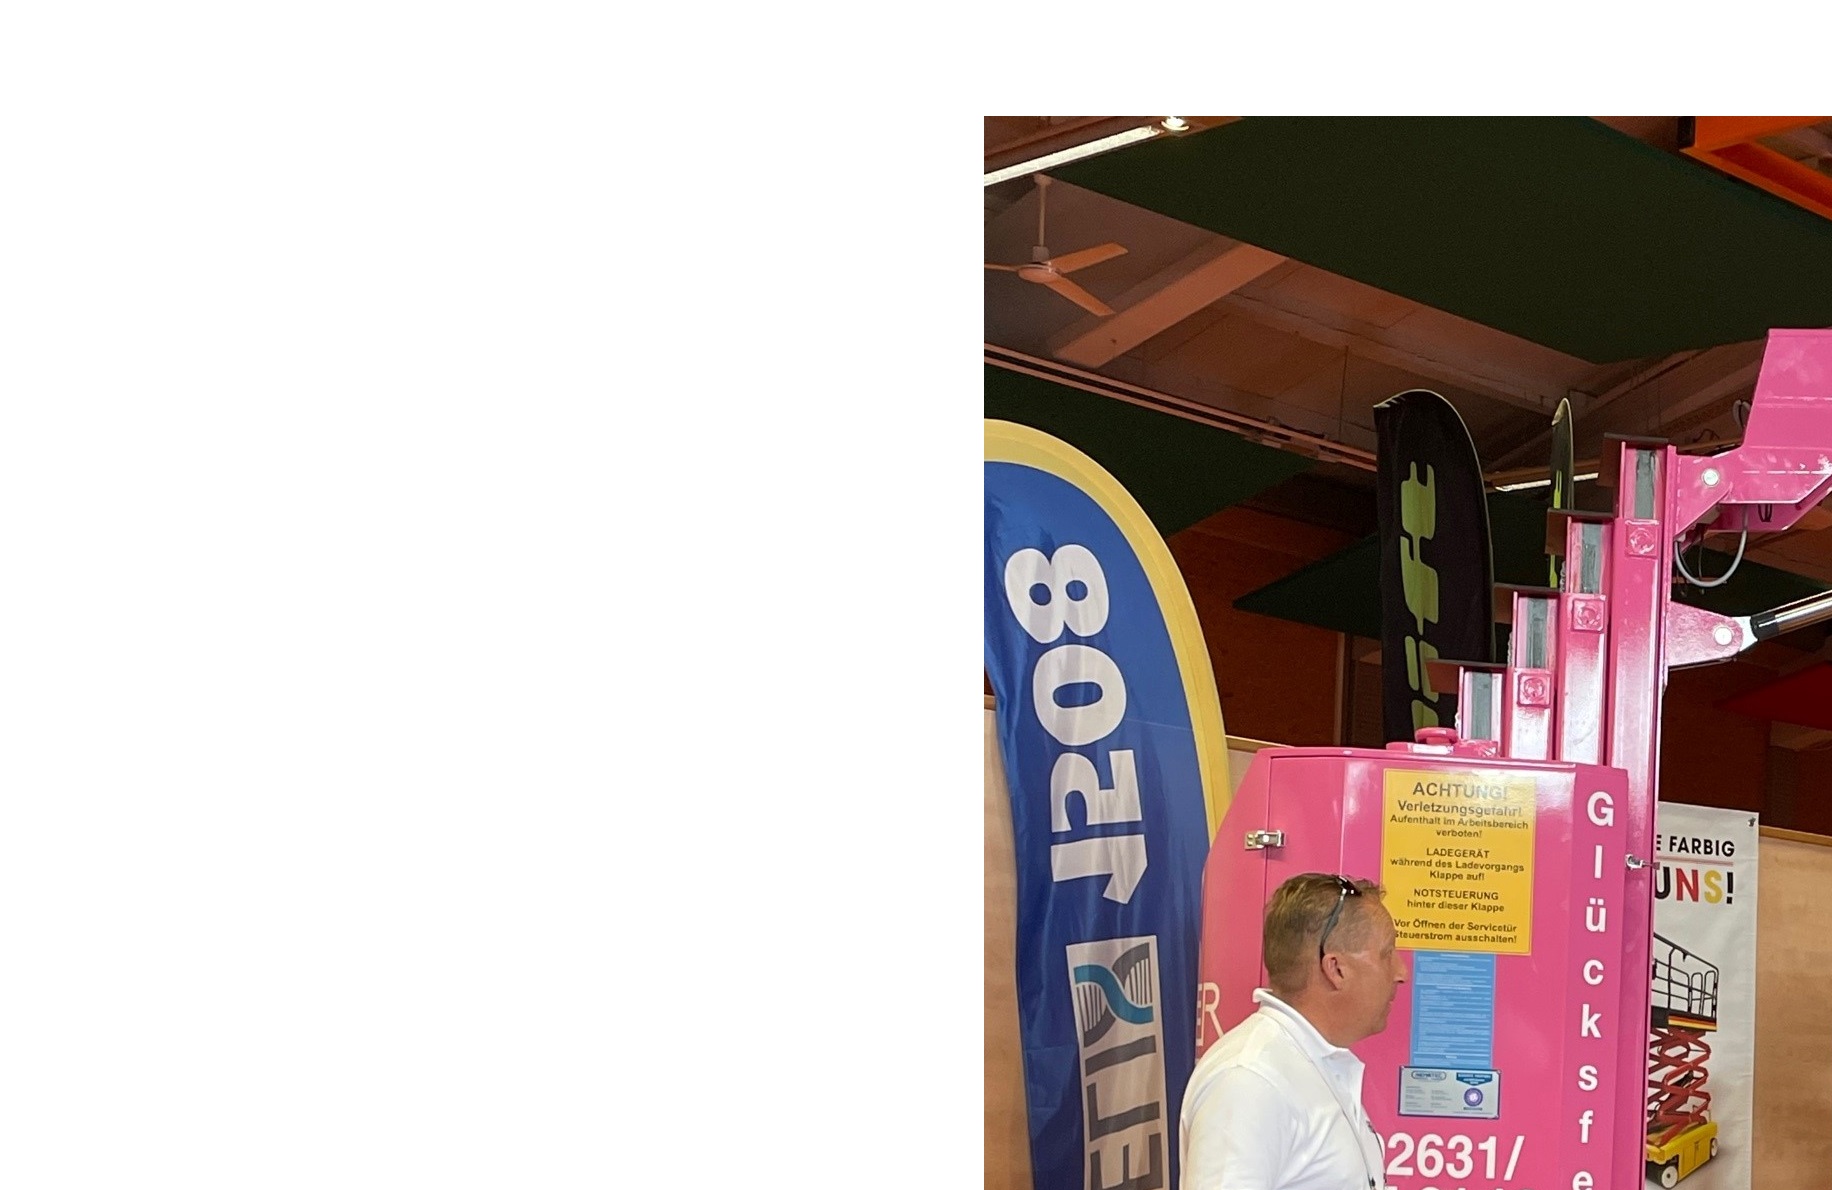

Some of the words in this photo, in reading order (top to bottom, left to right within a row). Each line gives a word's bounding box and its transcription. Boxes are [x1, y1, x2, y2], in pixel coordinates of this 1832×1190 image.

[1413, 782, 1508, 800] ACHTUNG!
[1398, 800, 1522, 817] Verletzungsgefahr!
[1390, 814, 1441, 825] Aufenthalt
[1443, 817, 1456, 826] im
[1457, 818, 1529, 830] Arbeitsbereich
[1436, 828, 1483, 838] verboten!
[1426, 847, 1490, 859] LADEGERÄT
[1669, 835, 1735, 857] FARBIG
[1390, 858, 1432, 868] während
[1435, 860, 1452, 868] des
[1455, 861, 1525, 874] Ladevorgangs
[1430, 871, 1463, 881] Klappe
[1466, 872, 1485, 881] auf!
[1654, 866, 1734, 904] UNS!
[1414, 889, 1499, 900] NOTSTEUERUNG
[1407, 899, 1435, 910] hinter
[1438, 901, 1468, 911] dieser
[1471, 902, 1505, 913] Klappe
[1393, 918, 1410, 928] Vor
[1413, 918, 1446, 929] Öffnen
[1449, 920, 1464, 930] der
[1467, 921, 1517, 933] Servicetür
[1455, 932, 1517, 944] ausschalten!
[1376, 1132, 1525, 1181] 2631/
